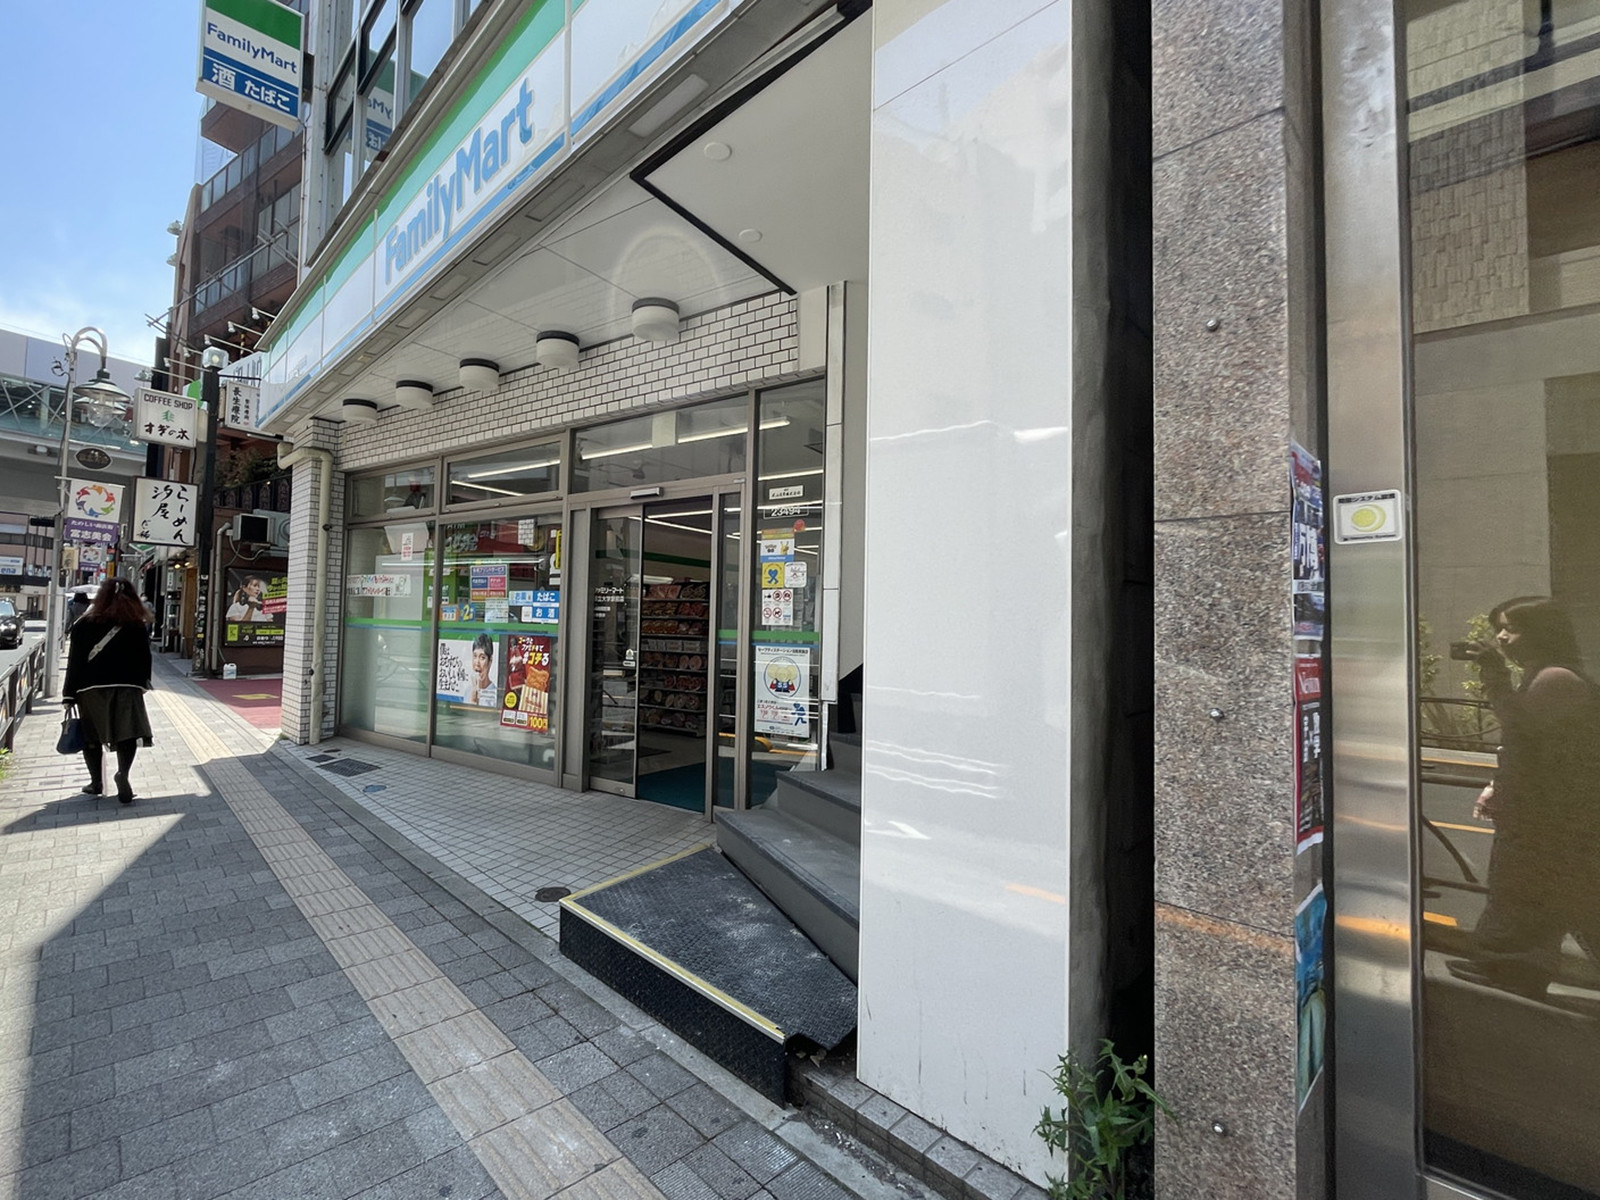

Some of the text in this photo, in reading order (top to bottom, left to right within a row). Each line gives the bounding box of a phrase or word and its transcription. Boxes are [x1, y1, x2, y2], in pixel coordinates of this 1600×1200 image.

[207, 22, 297, 74] FamilyMart
[211, 63, 290, 112] 酒 たばこ
[385, 77, 535, 286] FamilyMart
[144, 393, 193, 410] COFFEE SHOP
[172, 485, 189, 544] らーめん
[1338, 493, 1395, 503] システム
[536, 592, 556, 602] たばこ
